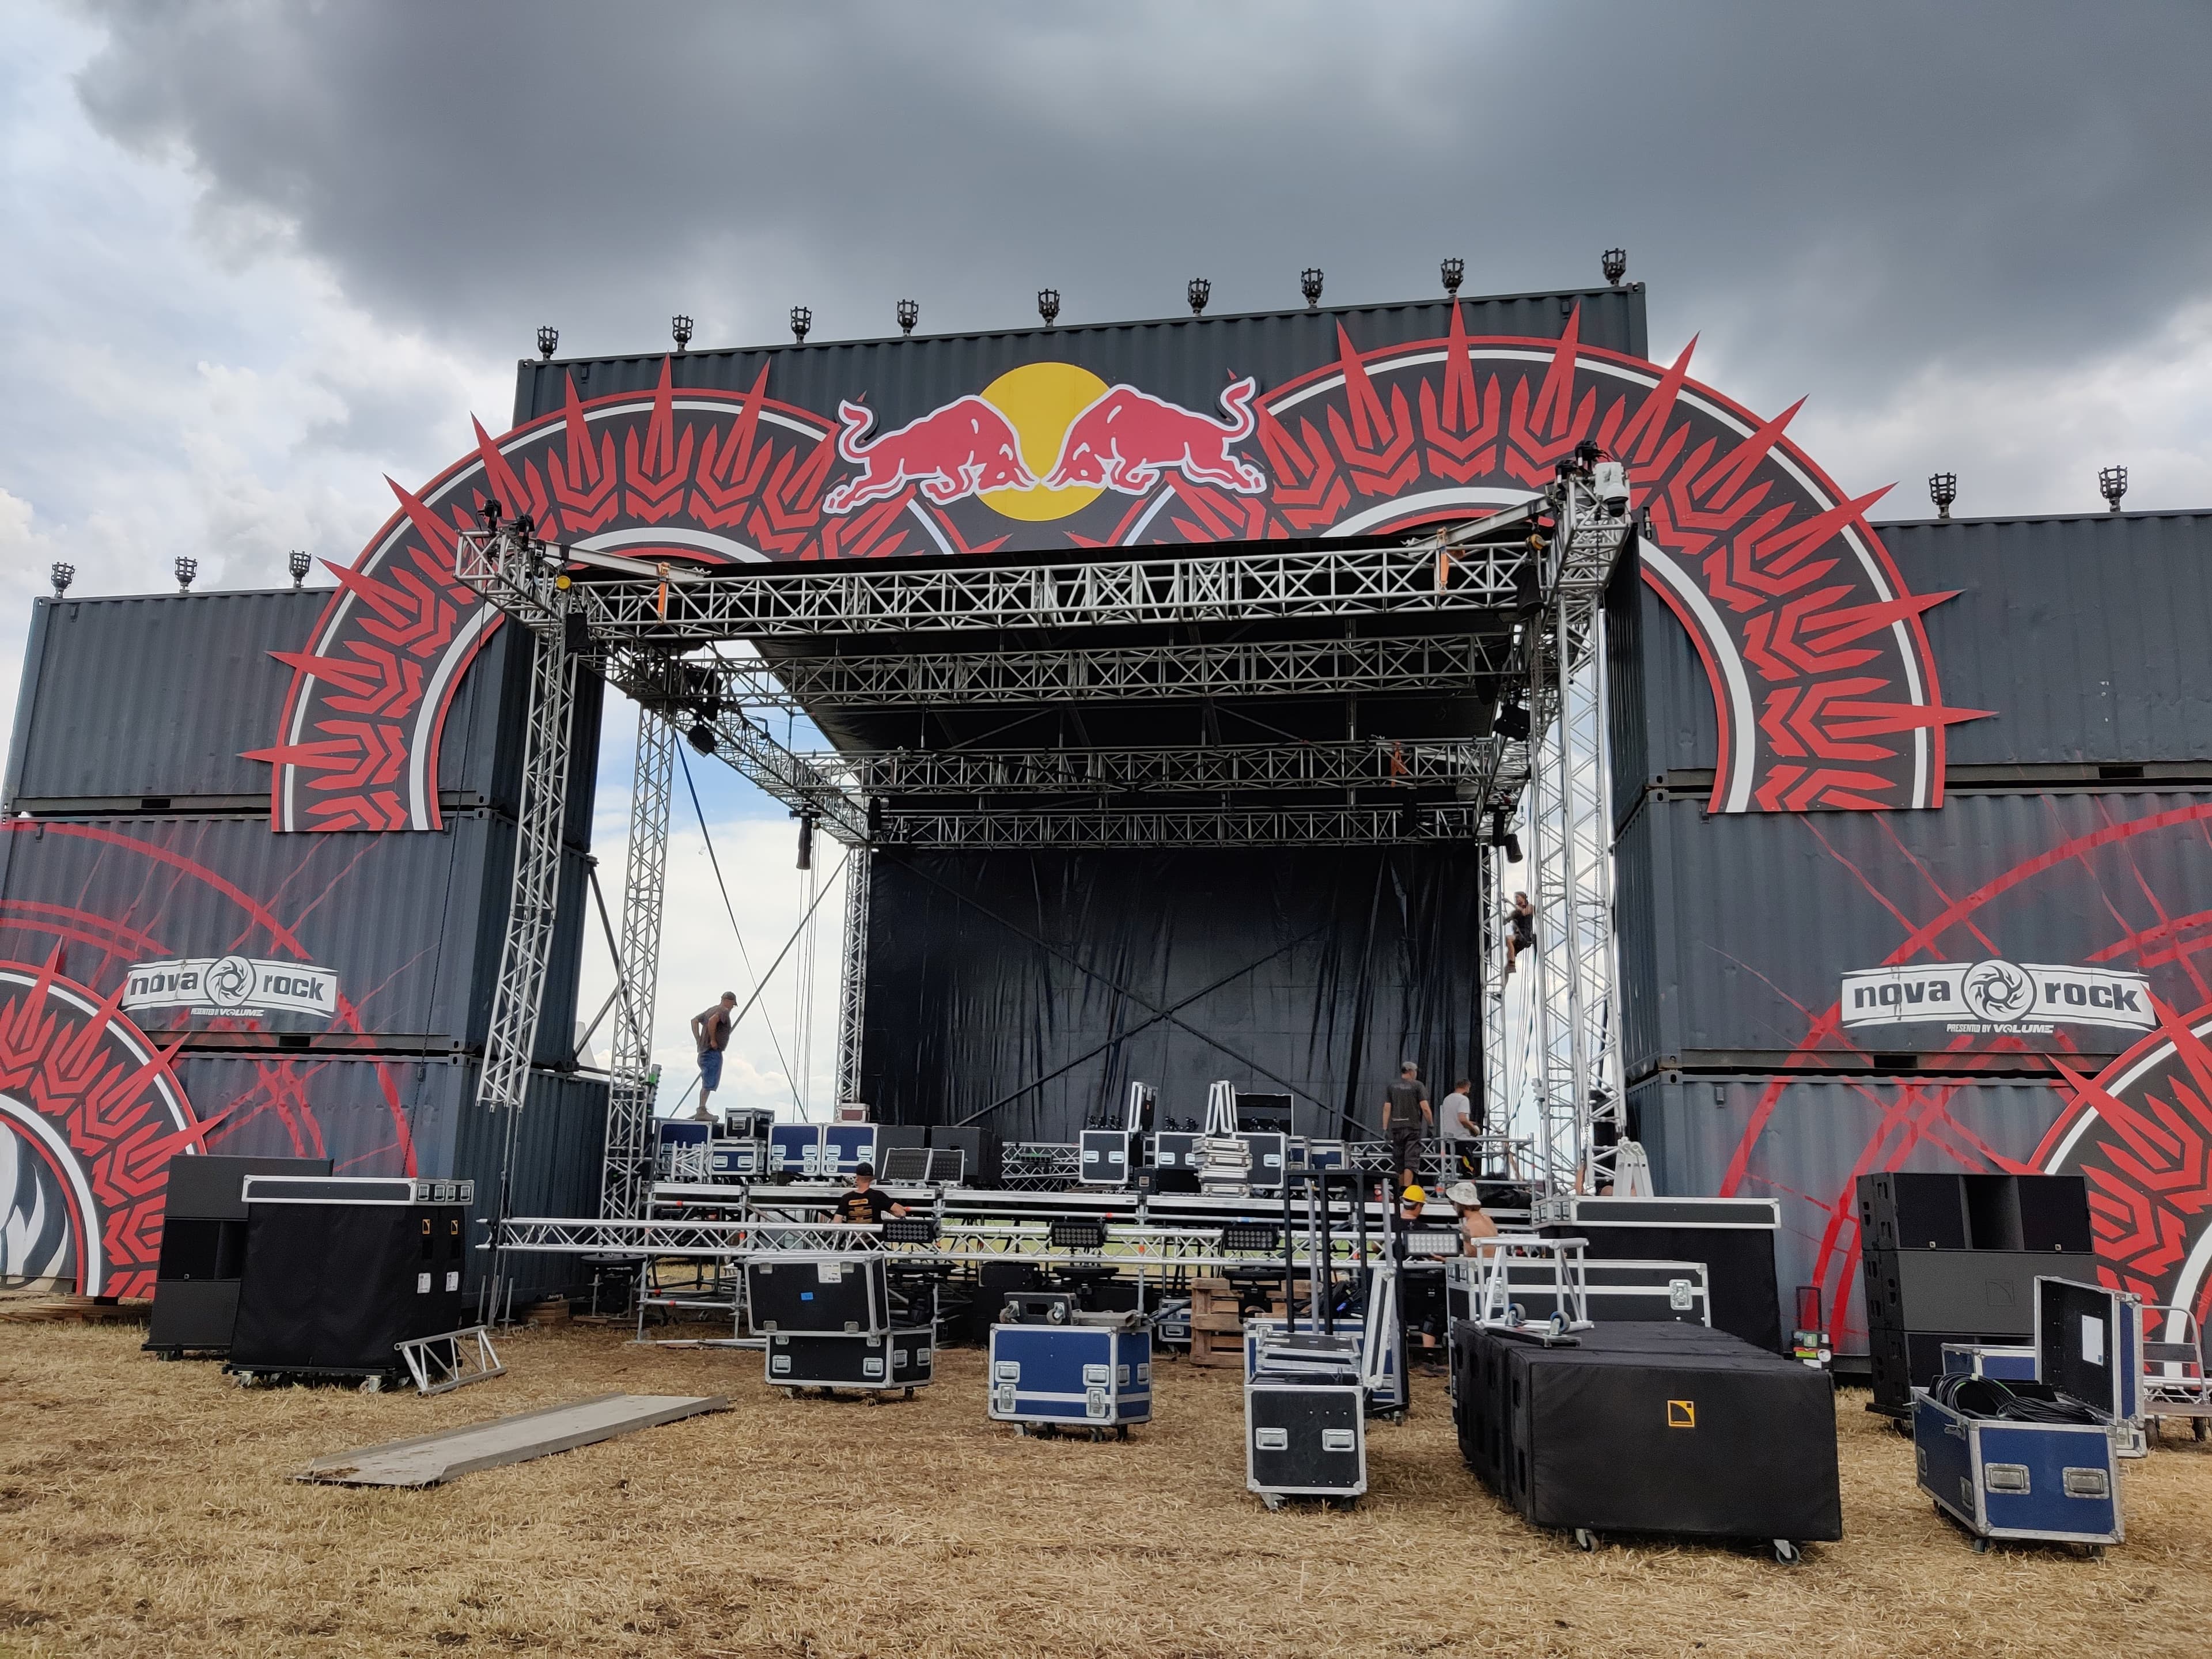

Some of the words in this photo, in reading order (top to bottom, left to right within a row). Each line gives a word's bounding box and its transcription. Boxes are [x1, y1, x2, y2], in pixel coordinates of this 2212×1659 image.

[130, 971, 198, 996] nova
[263, 974, 324, 1001] rock
[1854, 980, 1951, 1009] nova
[2044, 982, 2138, 1012] rock
[219, 1008, 264, 1017] VOLUME
[1982, 1024, 1991, 1033] BY
[1993, 1024, 2054, 1033] VOLUME
